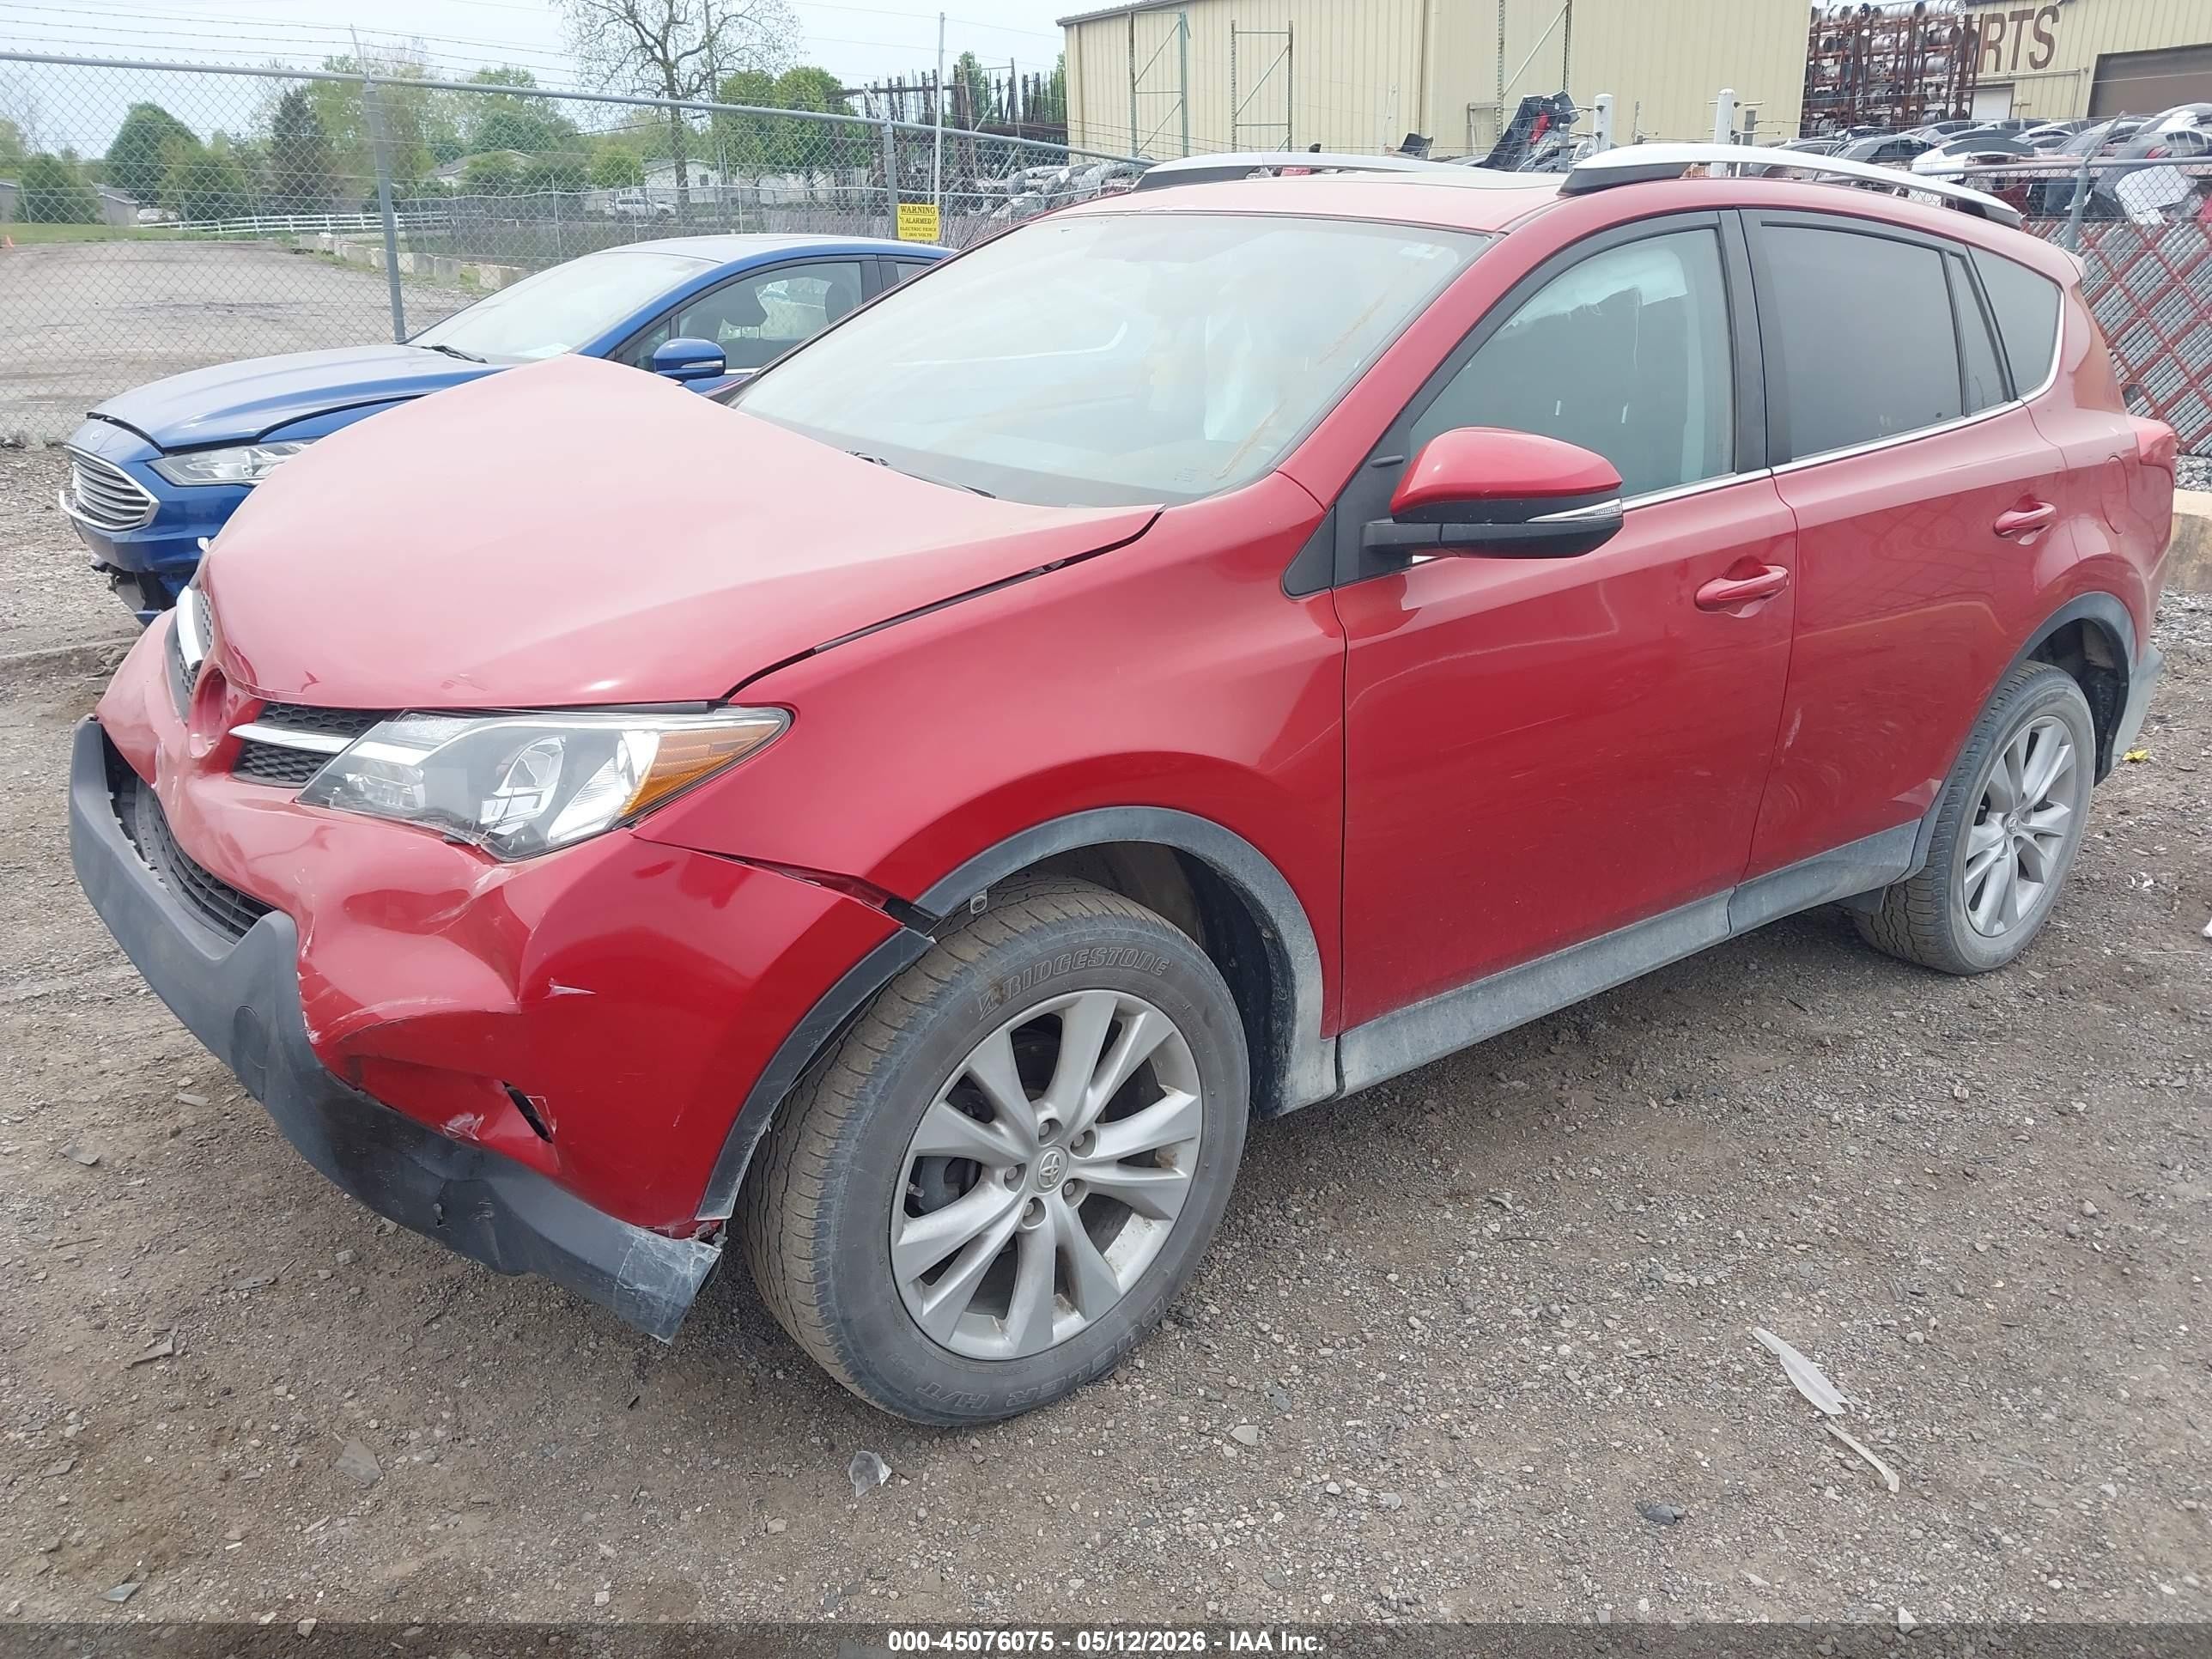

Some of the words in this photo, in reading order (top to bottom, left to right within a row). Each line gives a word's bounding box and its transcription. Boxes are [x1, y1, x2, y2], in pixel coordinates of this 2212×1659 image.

[1978, 5, 2060, 74] RTS
[900, 205, 936, 214] WARNING
[1001, 947, 1170, 1000] BRIDGESTONE
[1005, 1295, 1165, 1408] DUELER
